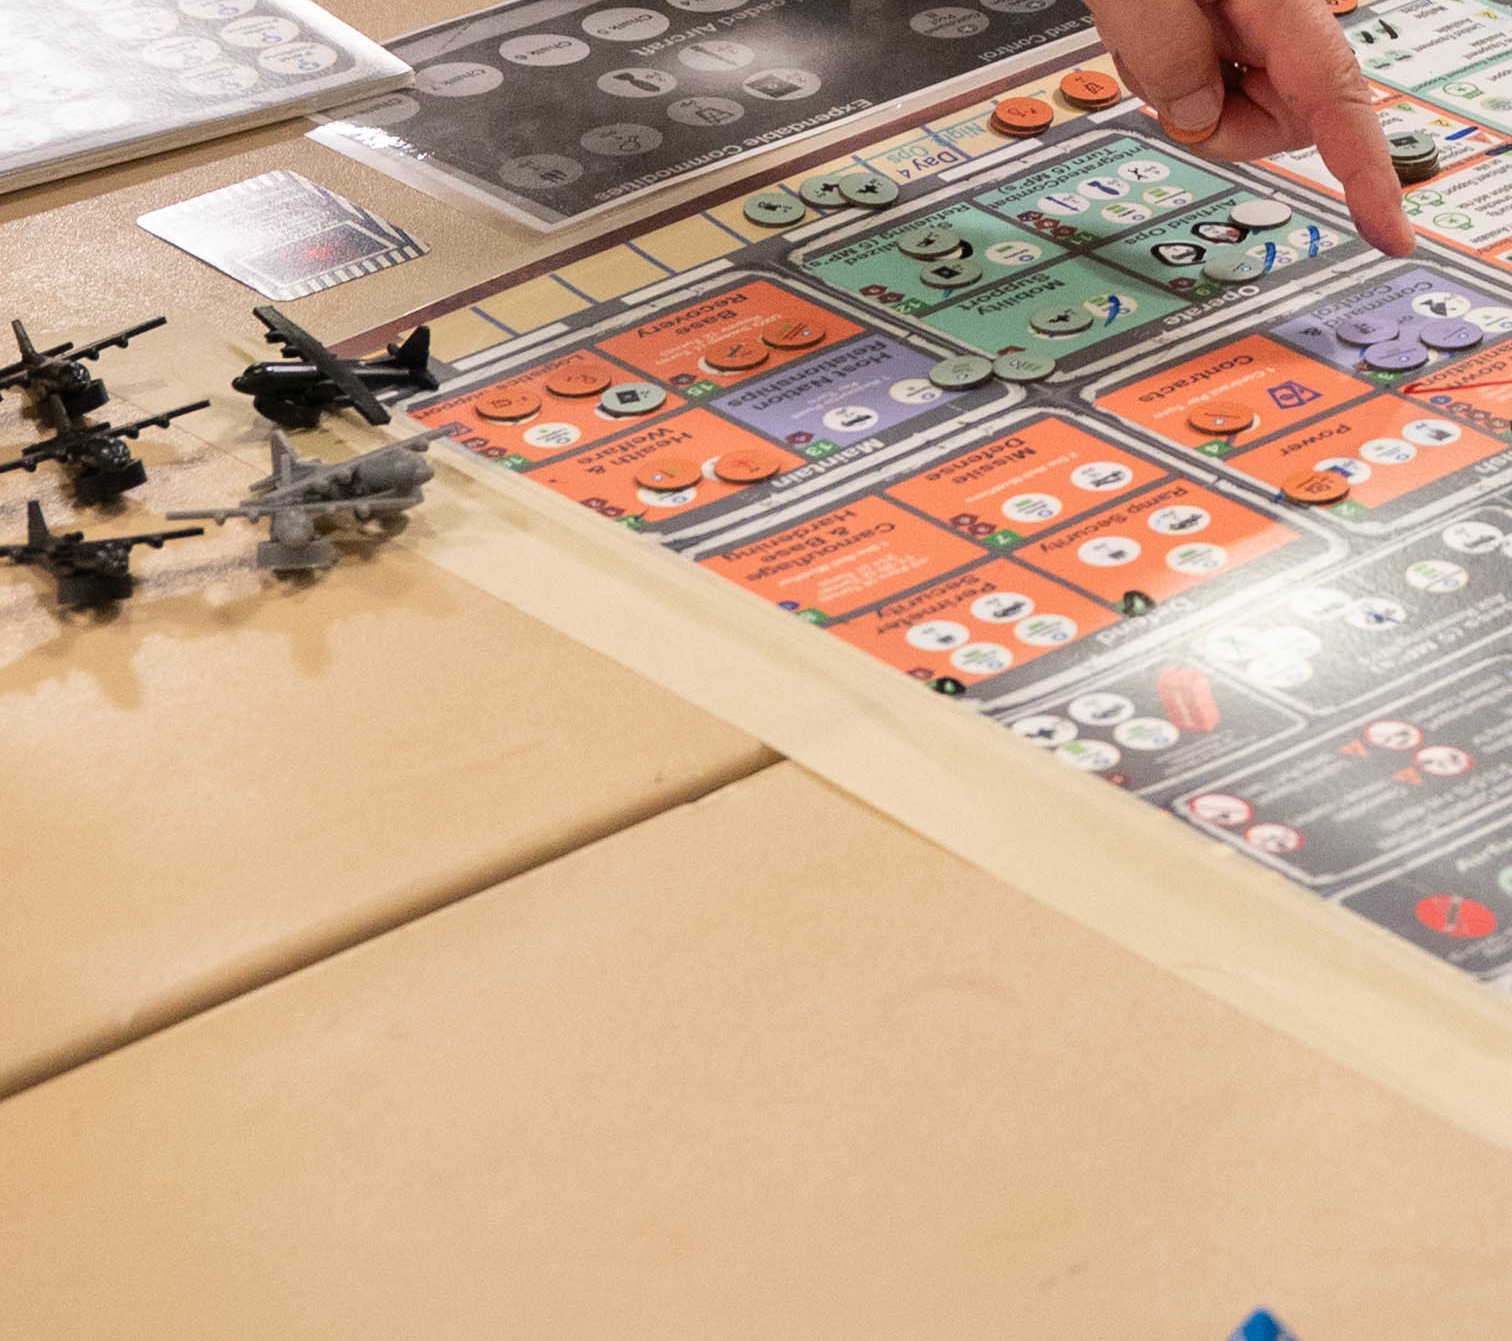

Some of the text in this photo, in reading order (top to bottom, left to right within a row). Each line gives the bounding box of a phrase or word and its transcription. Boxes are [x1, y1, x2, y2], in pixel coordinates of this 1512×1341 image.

[630, 21, 719, 58] Aircraft
[978, 32, 1047, 63] Control
[590, 97, 874, 202] Expendable Commodities
[916, 149, 959, 175] Day
[884, 202, 972, 240] Refueling
[1124, 197, 1239, 248] Airfield Ops
[957, 271, 1053, 311] Support
[976, 278, 1066, 316] Mobility
[1162, 282, 1260, 327] Operate
[1308, 285, 1394, 321] Control
[1325, 279, 1434, 327] Command
[636, 293, 748, 340] Recovery
[675, 309, 737, 338] Base
[726, 339, 888, 410] Relationships
[754, 353, 892, 415] Host Nation
[1138, 353, 1255, 405] Contracts
[576, 427, 674, 466] Welfare
[610, 431, 693, 465] Health
[923, 435, 1024, 482] Defense
[1278, 423, 1351, 458] Power
[770, 437, 885, 489] Maintain
[950, 446, 1037, 487] Missile
[1039, 484, 1189, 555] Ramp Security
[745, 522, 896, 582] Camouflage
[761, 538, 825, 565] Base
[872, 574, 980, 620] Security
